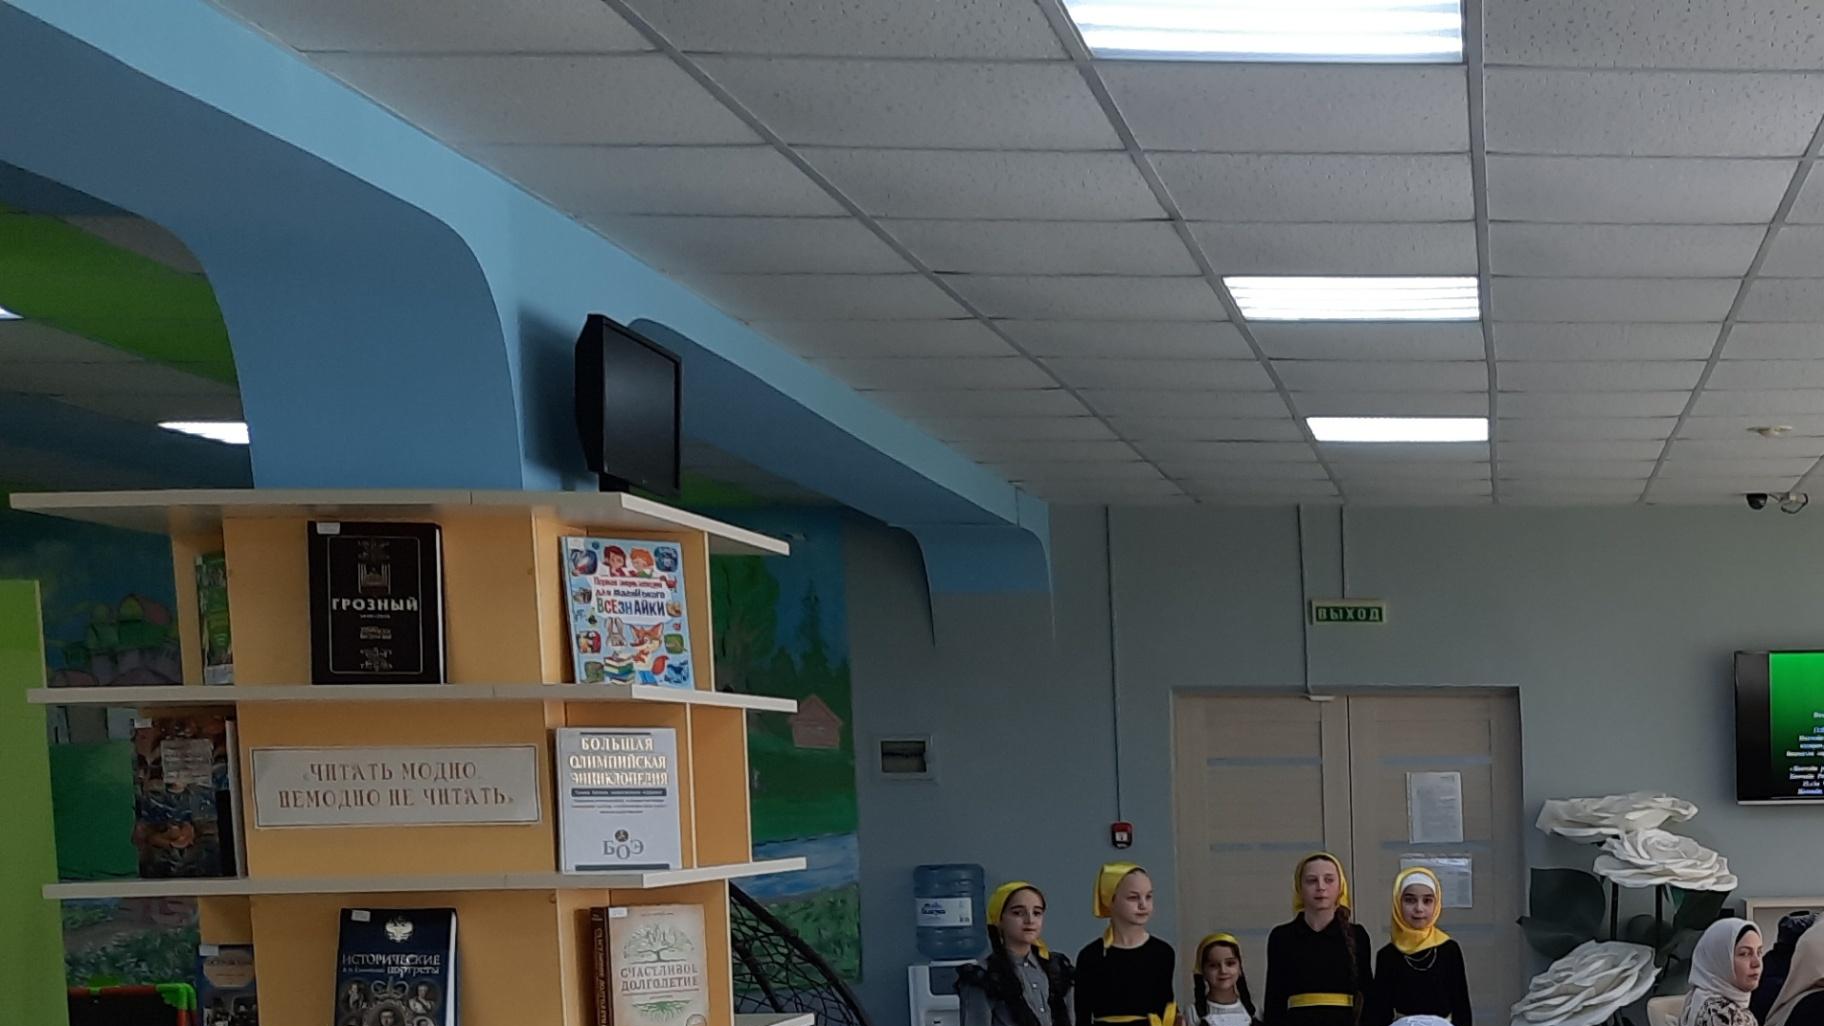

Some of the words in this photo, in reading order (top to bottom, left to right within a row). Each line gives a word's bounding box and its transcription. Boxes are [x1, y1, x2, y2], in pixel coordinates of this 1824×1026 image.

[331, 596, 418, 611] ГРОЗНЫЙ
[596, 598, 666, 617] ВСЕЗНАЙКИ
[1317, 607, 1381, 621] ВЫХОД
[581, 736, 654, 752] БОЛЬШАЯ
[569, 753, 667, 769] ОЛИМПИЙСКАЯ
[571, 771, 668, 786] ЭНЦИКЛОПЕДИЯ
[278, 788, 382, 810] НЕМОДНО
[389, 788, 416, 807] НЕ
[342, 953, 441, 966] ИСТОРИЧЕСКИЕ
[620, 963, 698, 978] СЧАСТЛИВОЕ
[621, 976, 699, 992] ДОЛГОЛЕТИЕ
